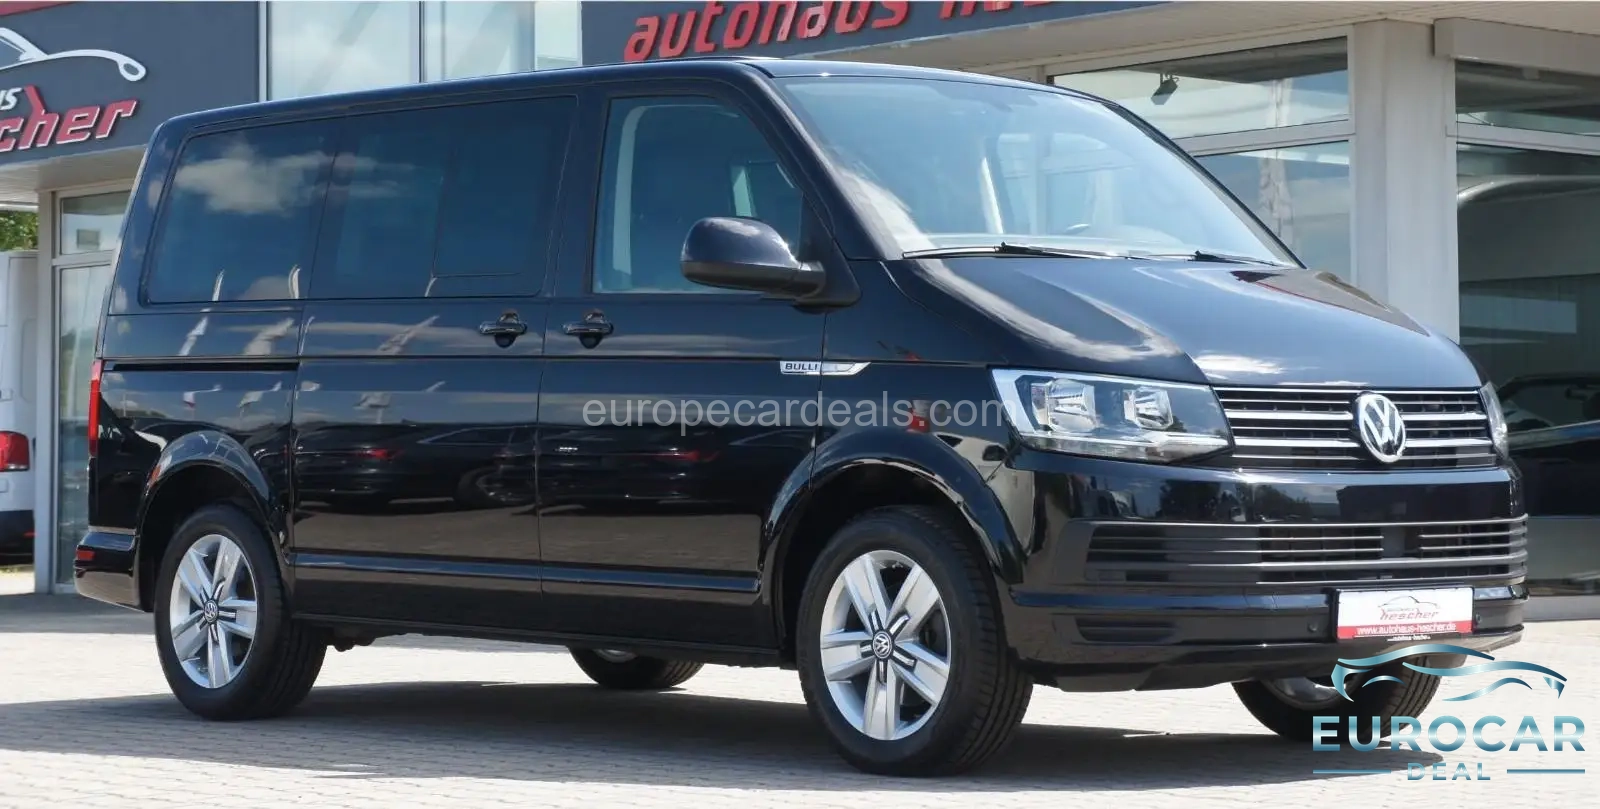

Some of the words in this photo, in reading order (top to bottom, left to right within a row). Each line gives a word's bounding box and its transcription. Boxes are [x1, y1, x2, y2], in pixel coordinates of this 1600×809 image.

[785, 362, 818, 371] BULLI
[1380, 608, 1439, 621] hescher
[1357, 622, 1457, 635] www.autohaus-hescher.de
